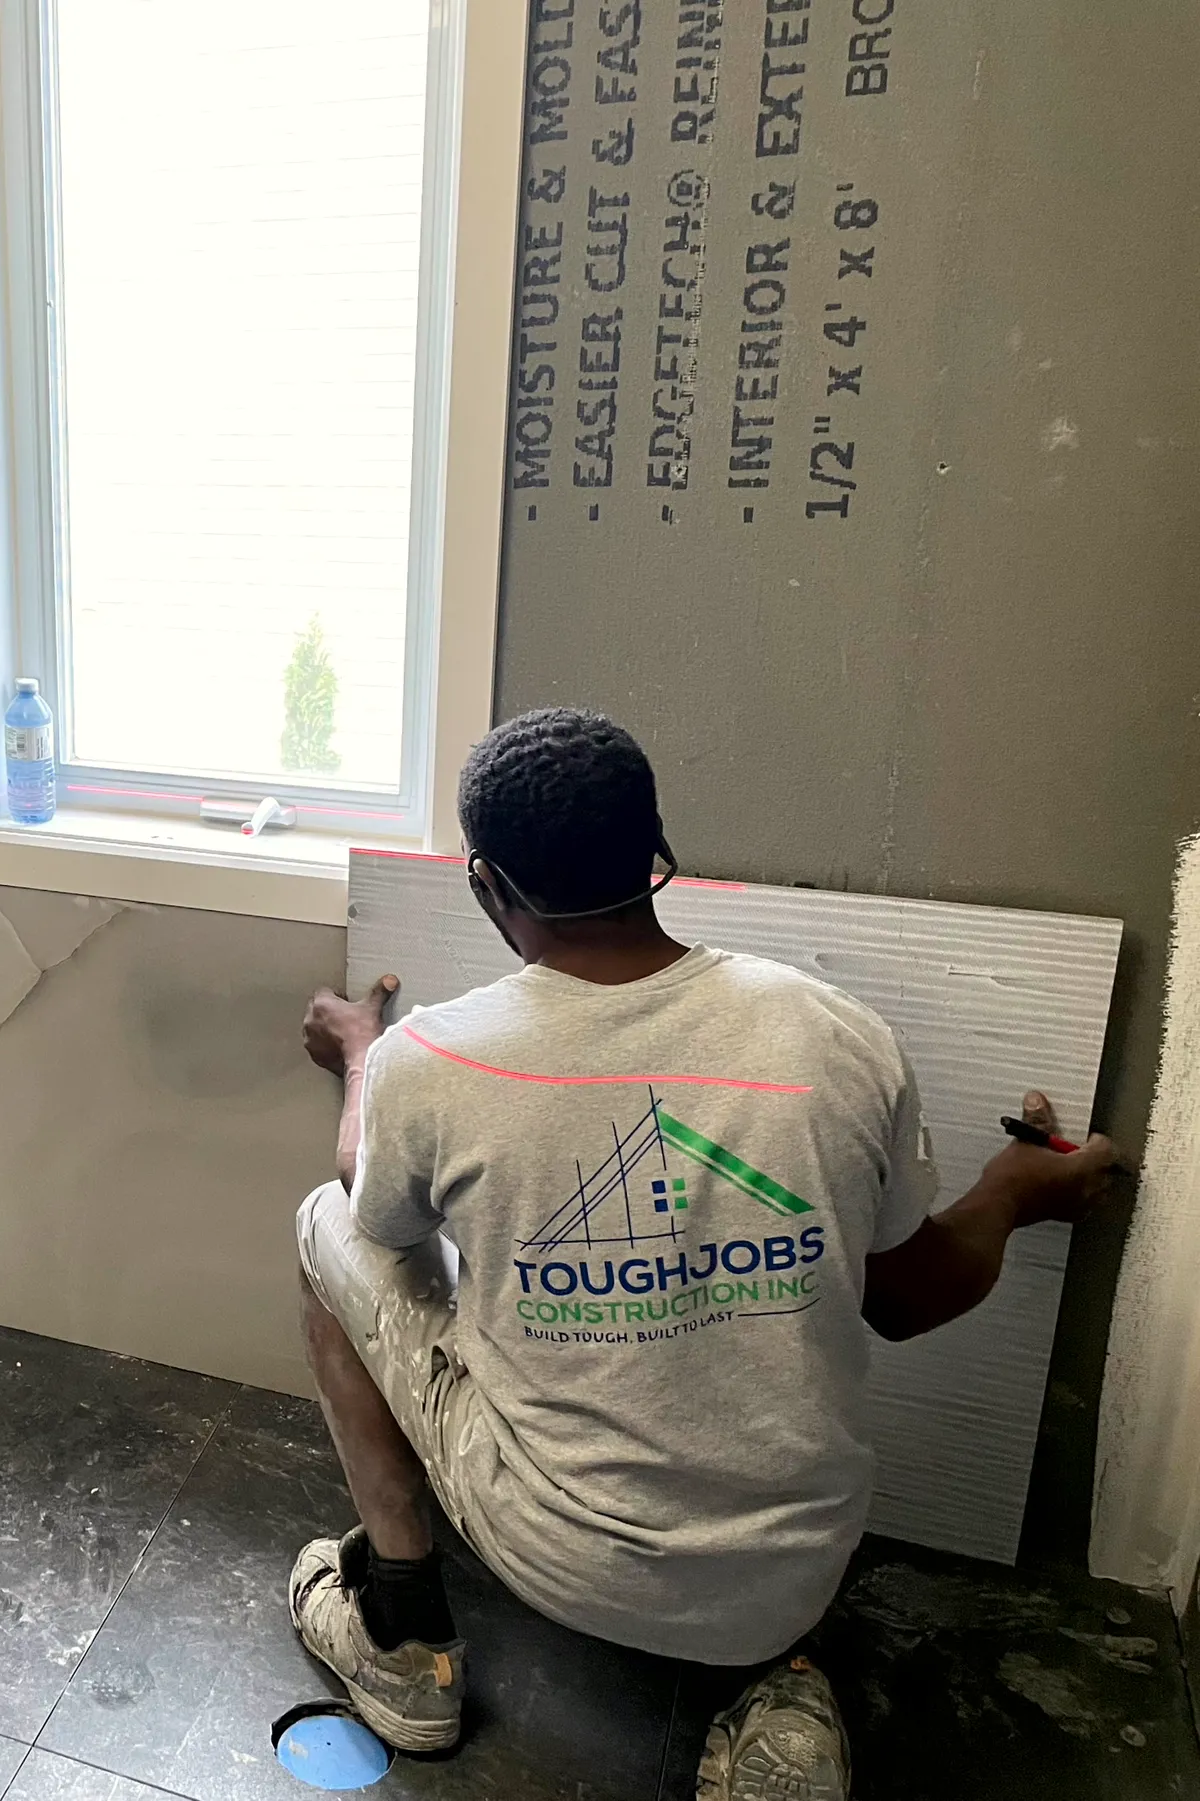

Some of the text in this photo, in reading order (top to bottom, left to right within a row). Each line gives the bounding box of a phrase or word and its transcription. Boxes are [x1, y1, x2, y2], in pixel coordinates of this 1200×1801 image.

[594, 0, 642, 104] FAS
[591, 117, 635, 166] &
[527, 165, 566, 203] &
[750, 180, 796, 220] &
[834, 182, 878, 230] 8'
[585, 185, 630, 292] CUT
[823, 303, 866, 348] 4'
[513, 221, 563, 489] MOISTURE
[728, 236, 790, 489] INTERIOR
[573, 306, 623, 487] EASIER
[805, 416, 856, 519] 1/2"
[516, 1279, 760, 1324] CONSTRUCTION
[524, 1326, 570, 1343] BUILD
[636, 1325, 679, 1343] BUILT
[680, 1319, 698, 1334] TO
[700, 1311, 735, 1327] LAST
